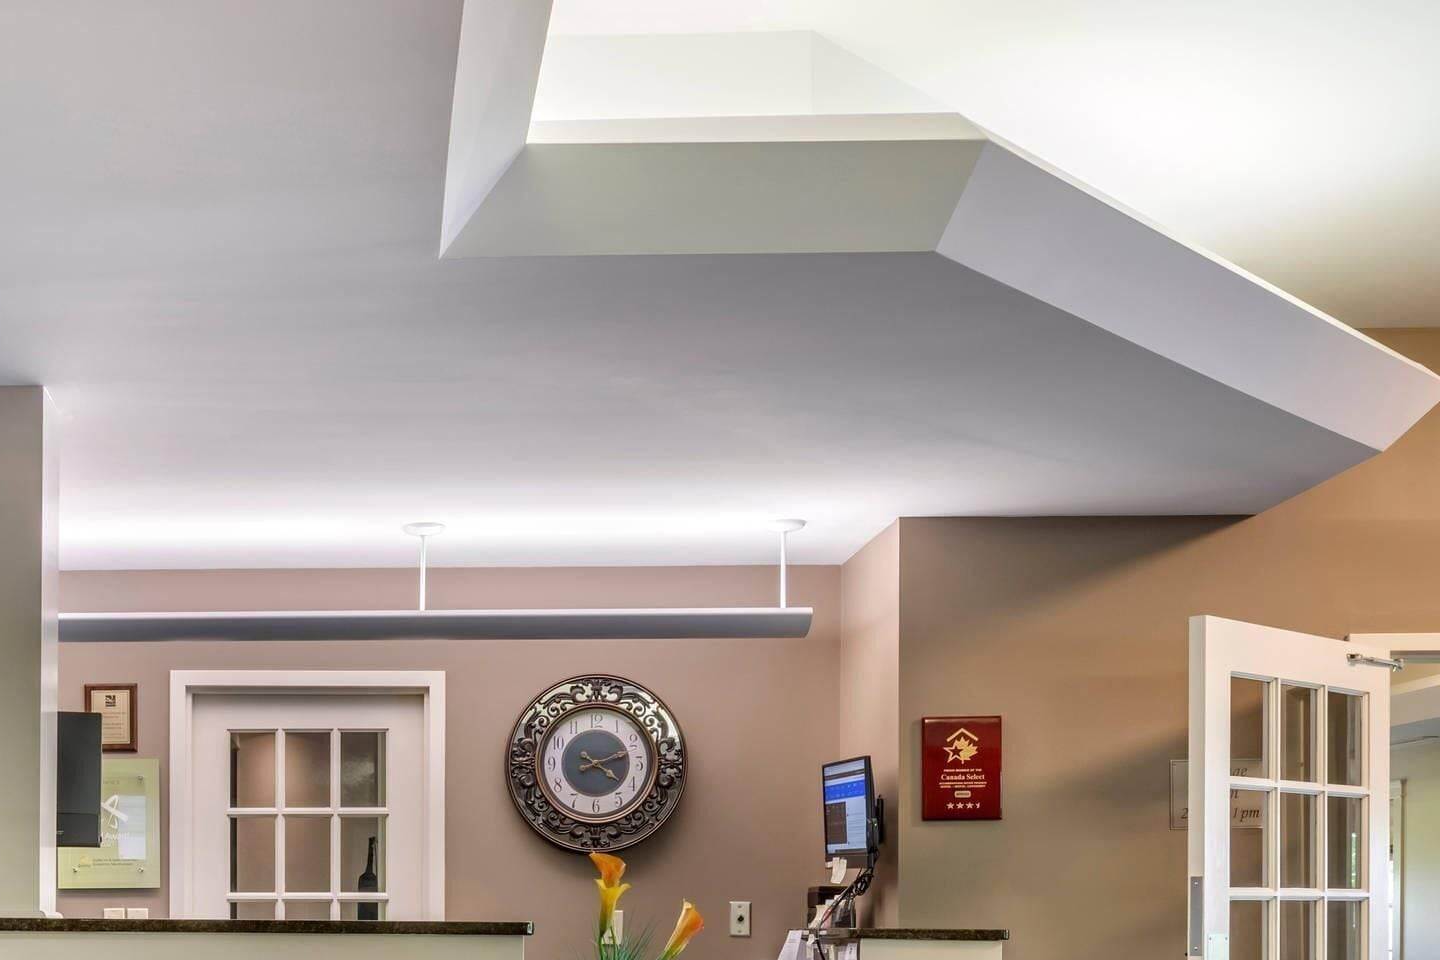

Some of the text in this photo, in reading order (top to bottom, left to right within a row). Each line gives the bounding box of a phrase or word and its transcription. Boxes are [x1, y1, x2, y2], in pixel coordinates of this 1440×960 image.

[569, 720, 578, 735] 11
[590, 714, 603, 728] 12
[553, 735, 565, 750] 10
[629, 734, 639, 748] 2
[547, 756, 556, 771] 9
[635, 756, 644, 771] 3
[629, 776, 637, 792] 4
[966, 773, 985, 781] Select
[553, 778, 563, 793] 8
[570, 793, 578, 809] 7
[592, 799, 600, 813] 6
[615, 792, 623, 807] 5
[1239, 808, 1260, 823] pm
